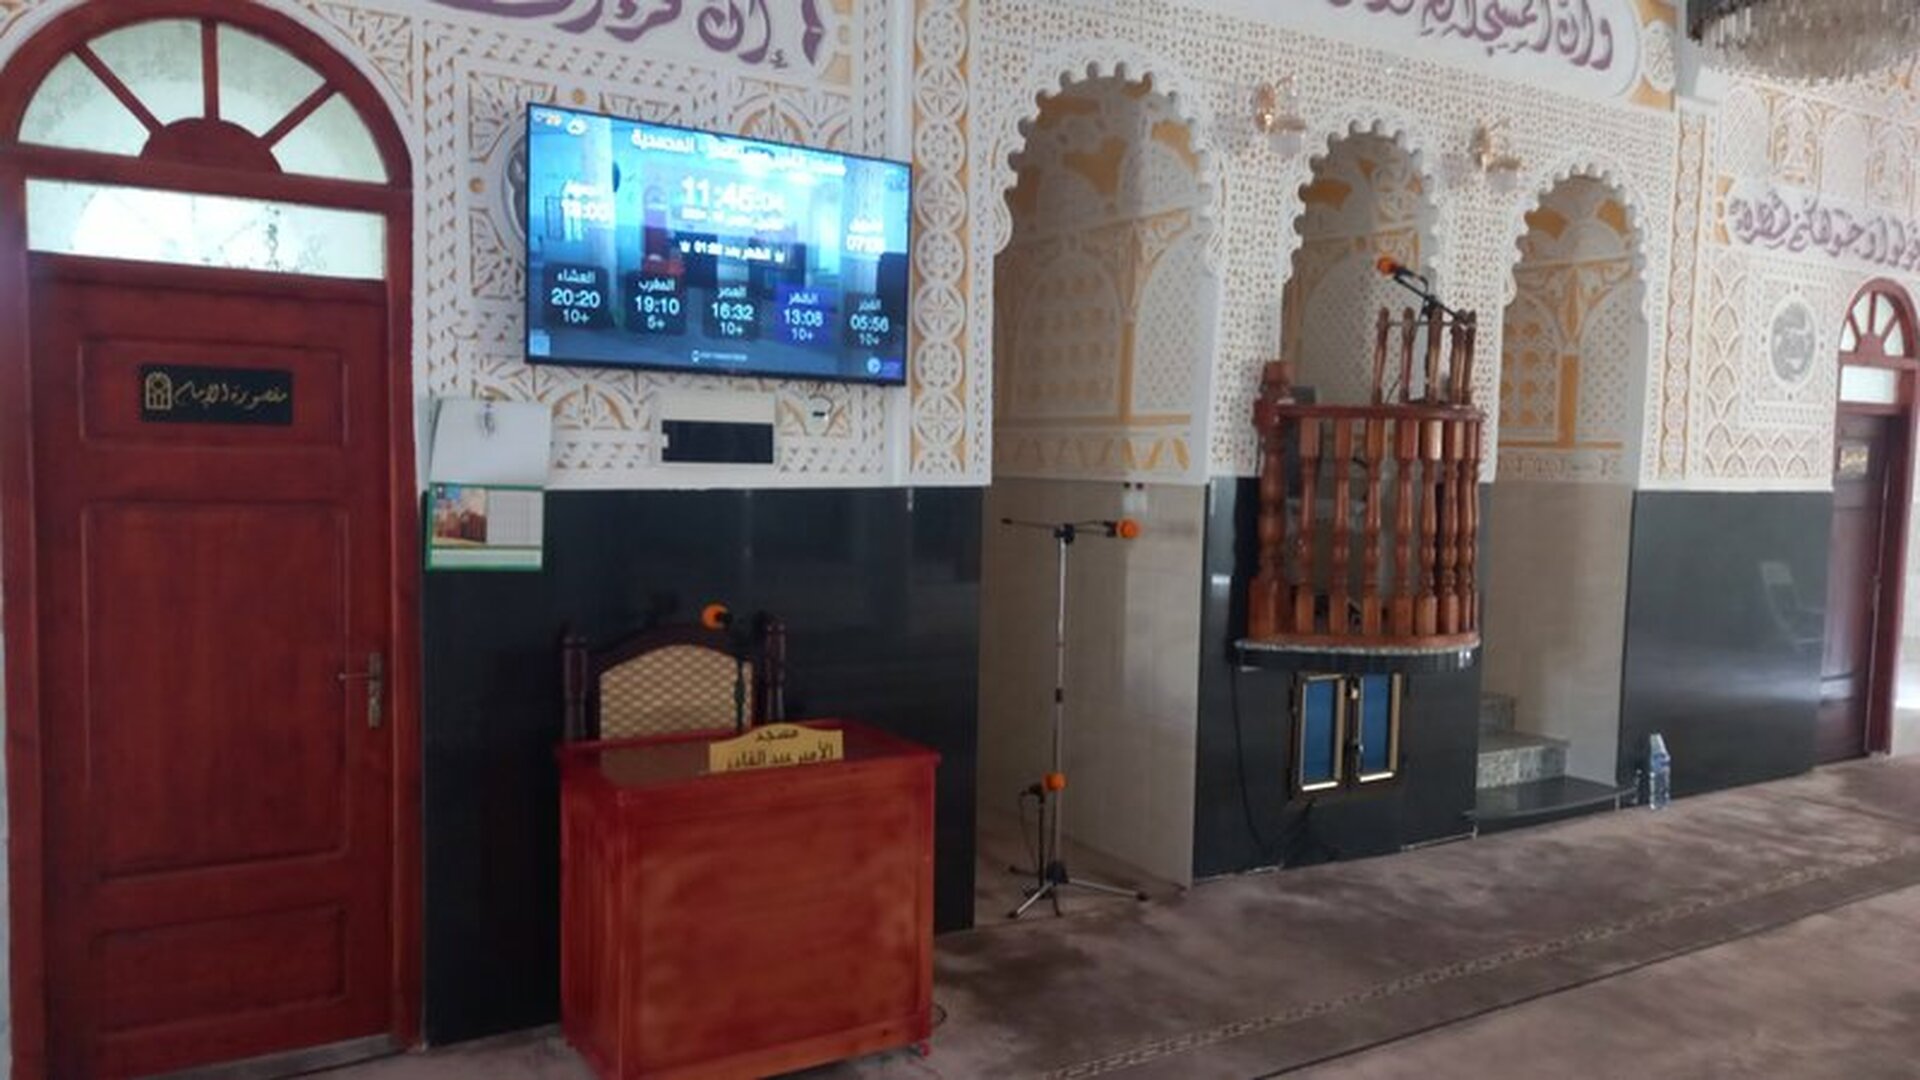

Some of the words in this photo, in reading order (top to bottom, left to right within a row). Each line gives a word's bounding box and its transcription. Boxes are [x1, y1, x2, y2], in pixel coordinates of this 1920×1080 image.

[557, 268, 596, 284] العشاء
[637, 277, 676, 293] المغرب
[551, 286, 601, 309] 20:20
[635, 294, 680, 316] 19:10
[711, 301, 754, 322] 16:32
[783, 308, 824, 328] 13:08
[756, 729, 799, 742] مسجد
